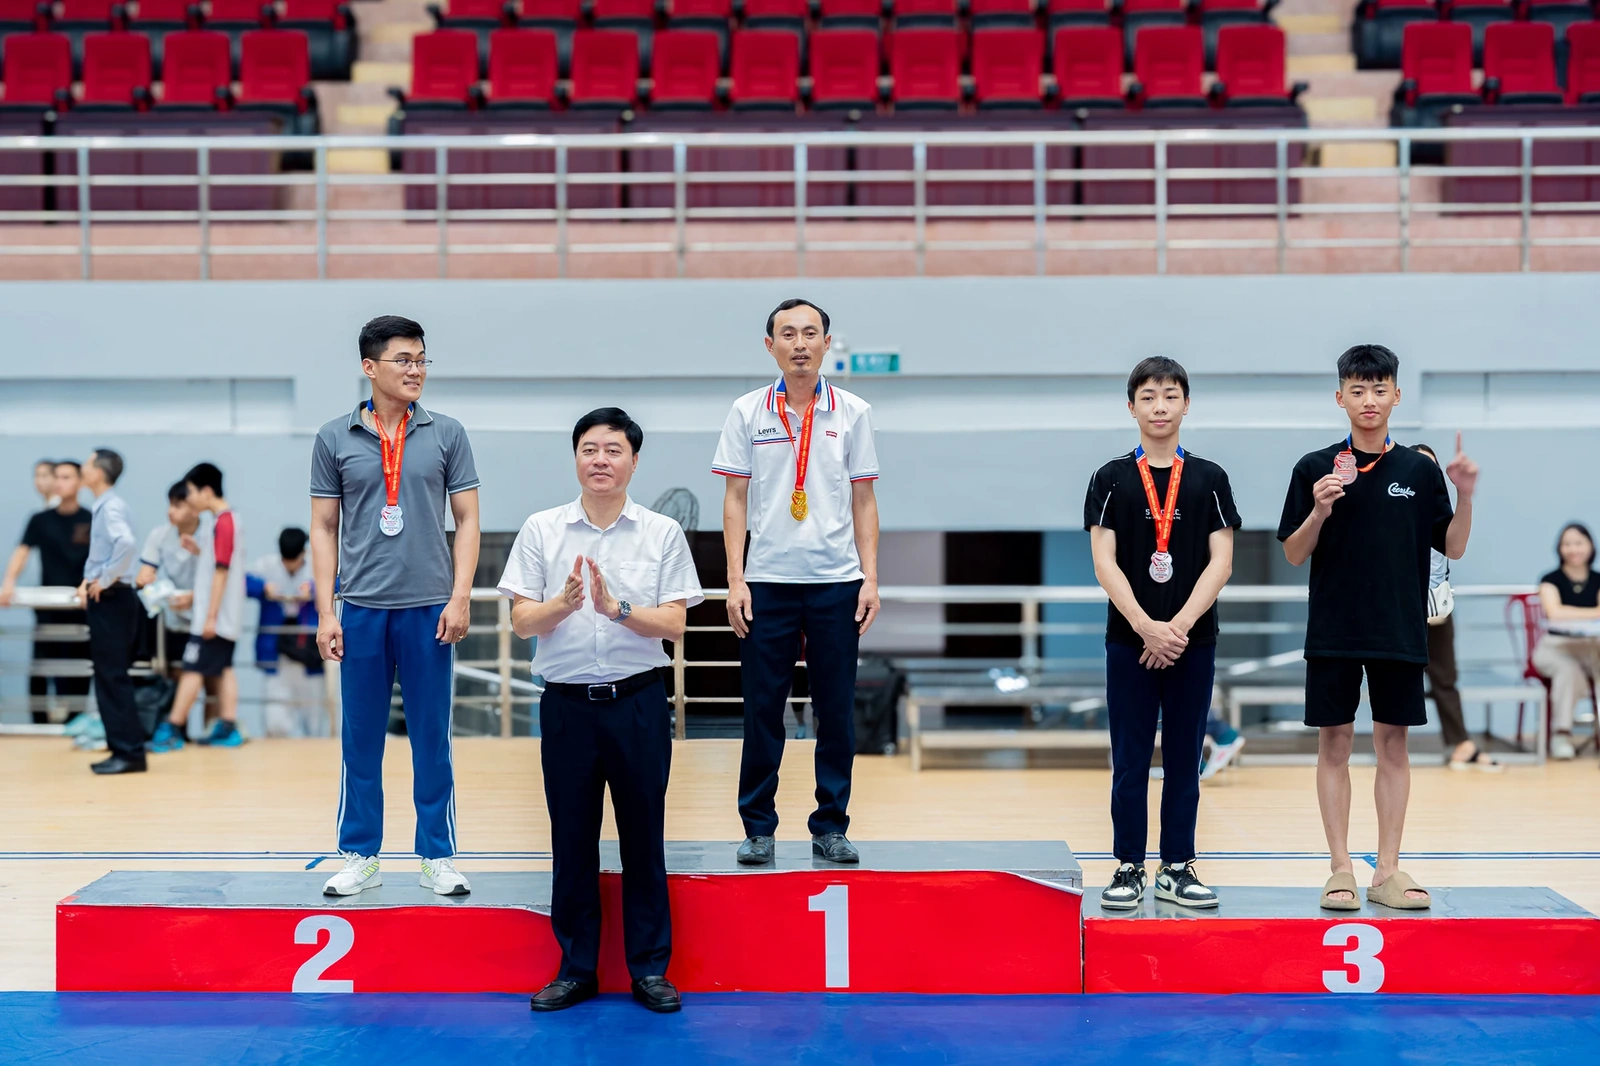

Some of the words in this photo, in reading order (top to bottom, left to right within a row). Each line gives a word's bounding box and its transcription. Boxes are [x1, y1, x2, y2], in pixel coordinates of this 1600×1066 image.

[292, 914, 355, 993] 2
[808, 884, 850, 988] 1
[1322, 923, 1385, 993] 3
